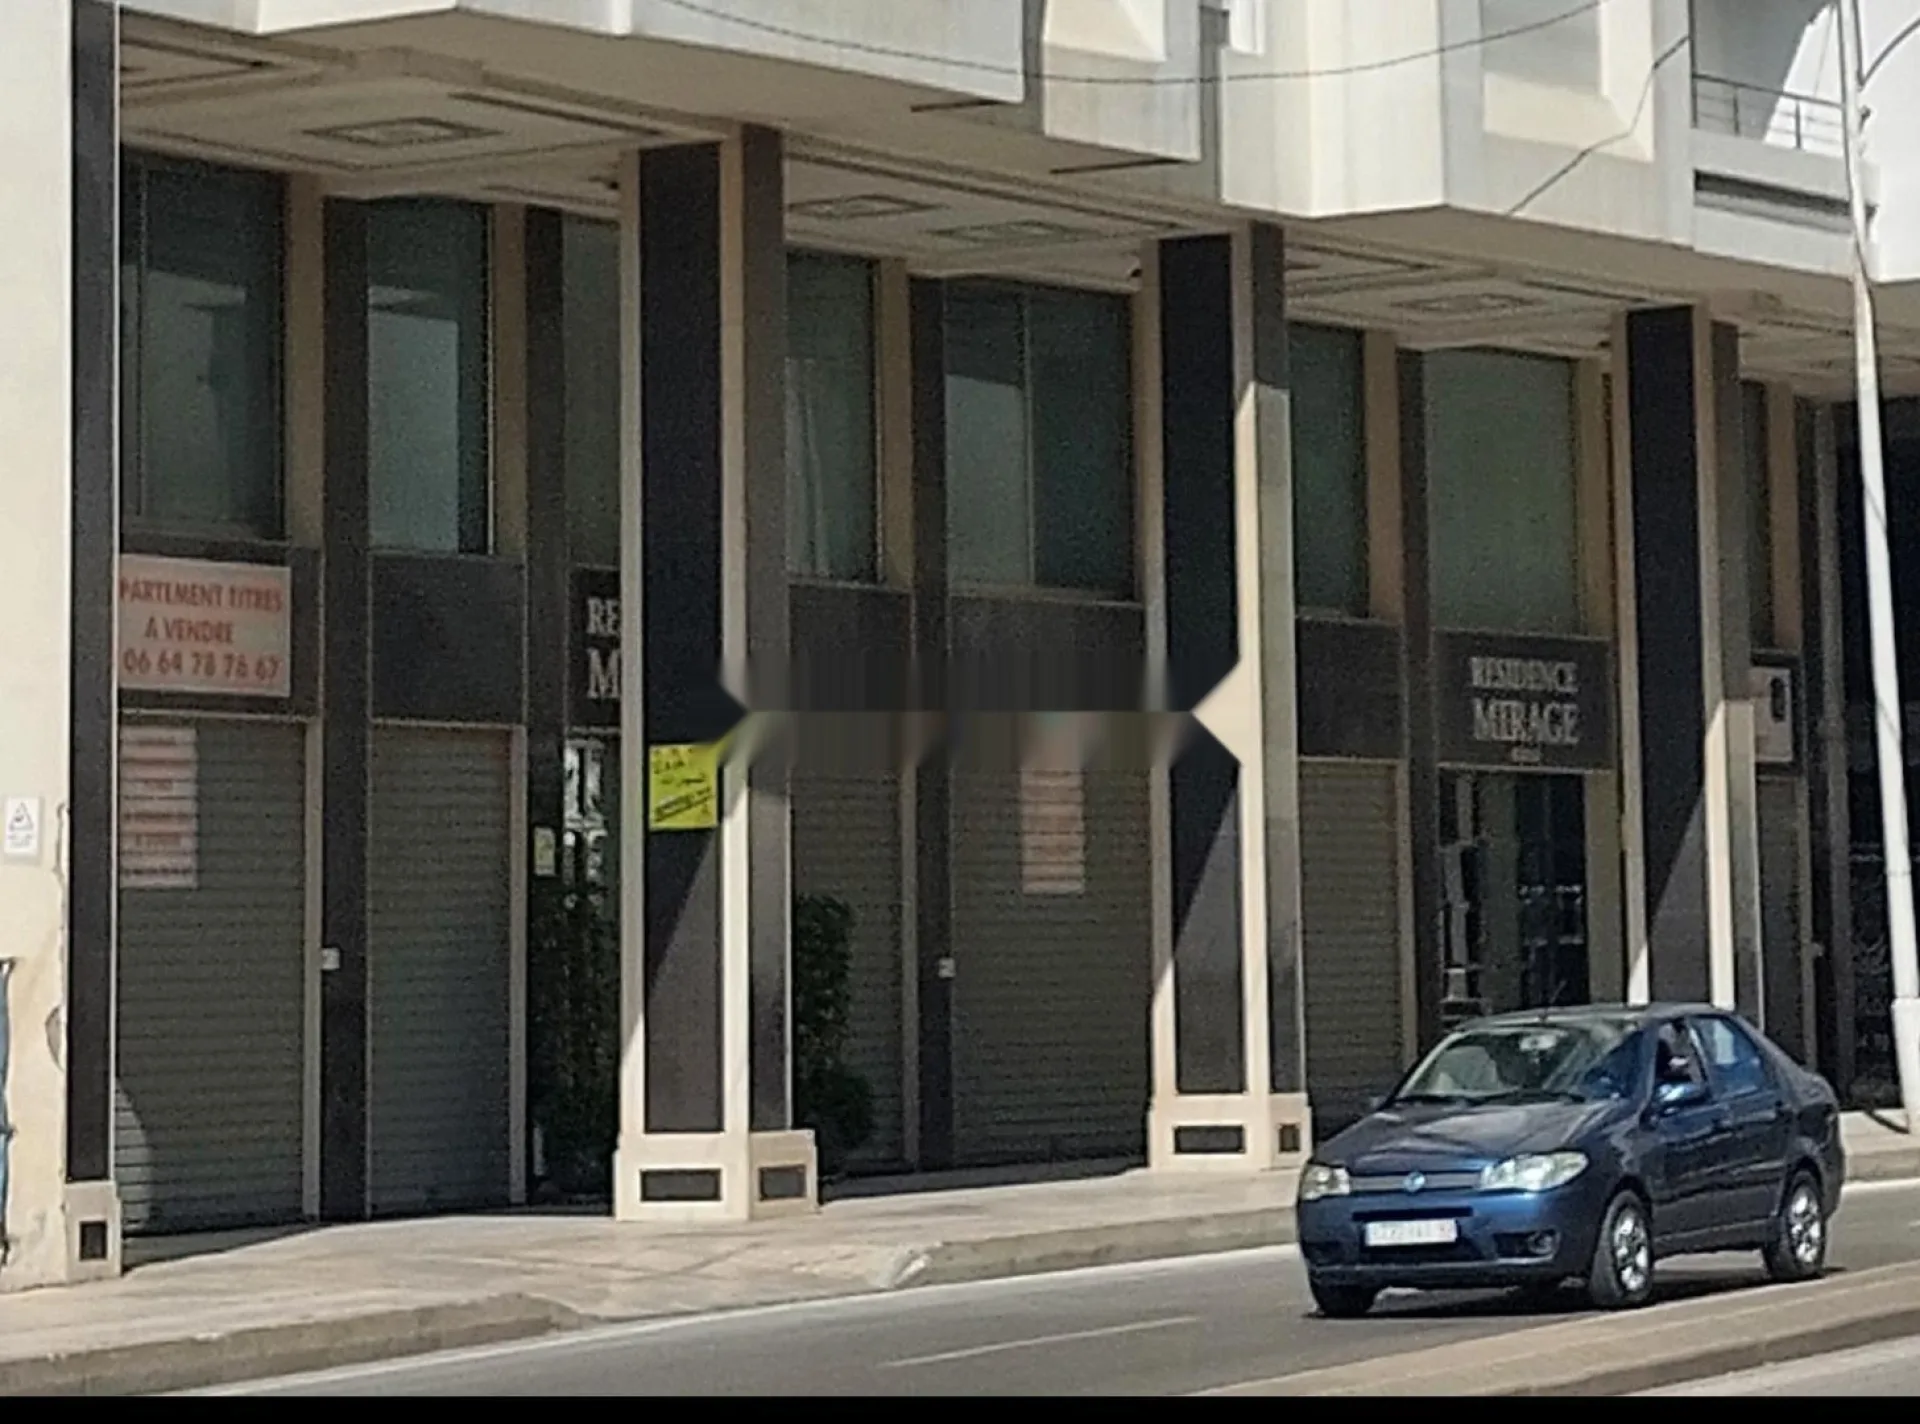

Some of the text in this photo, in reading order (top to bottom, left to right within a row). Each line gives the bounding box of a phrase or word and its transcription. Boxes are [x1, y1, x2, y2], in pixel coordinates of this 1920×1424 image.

[144, 616, 233, 644] A VENDRE
[123, 648, 152, 674] 06
[157, 649, 183, 675] 64
[1473, 698, 1579, 744] MIRAGE
